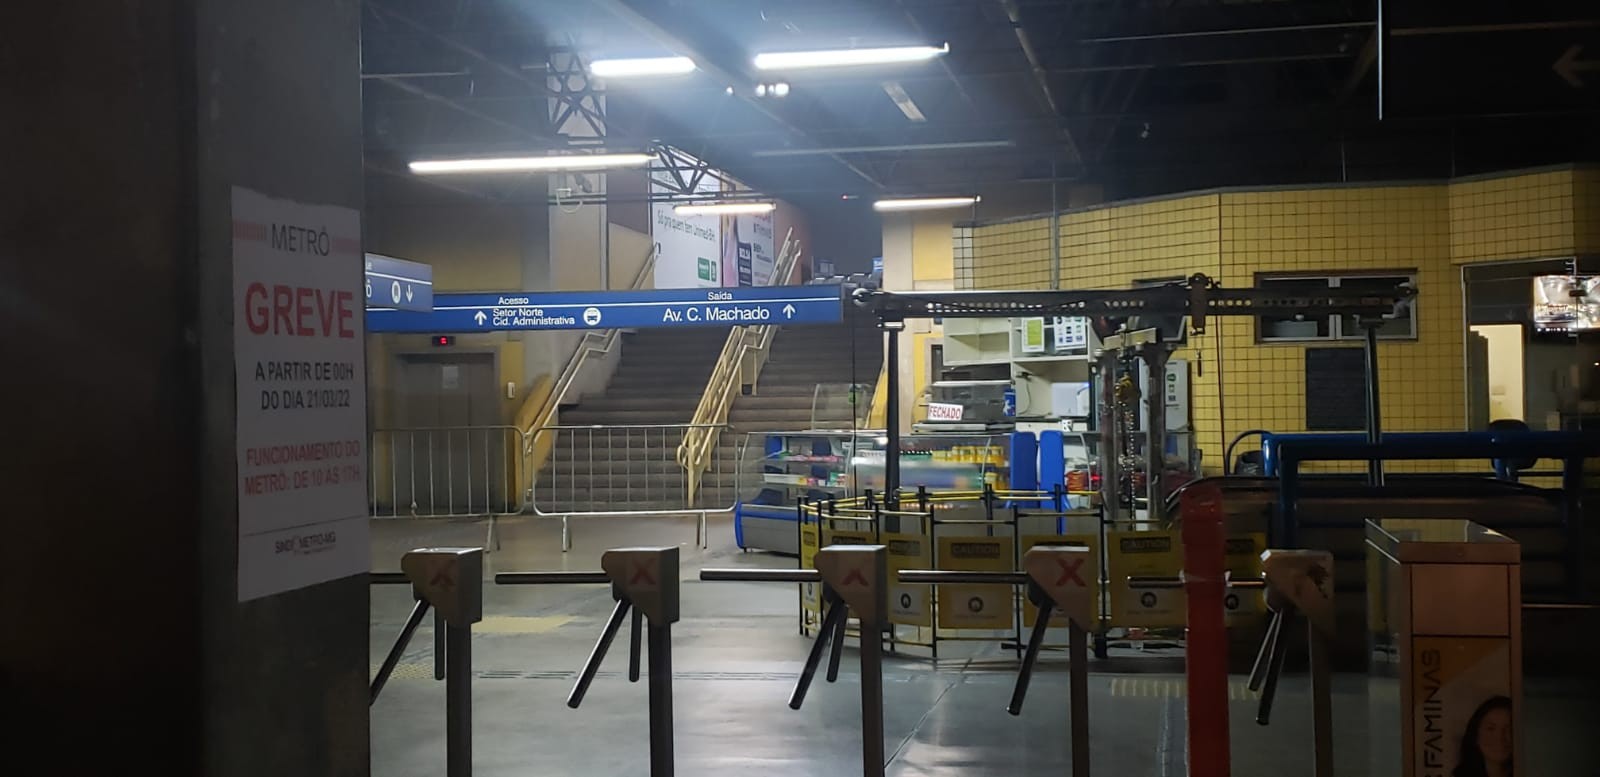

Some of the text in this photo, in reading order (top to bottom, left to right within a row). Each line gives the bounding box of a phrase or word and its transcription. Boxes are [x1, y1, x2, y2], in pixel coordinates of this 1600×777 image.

[271, 223, 329, 256] METRÔ
[498, 295, 529, 305] Acesso
[707, 290, 732, 301] Saída
[245, 282, 354, 338] GREVE
[492, 307, 543, 317] Setor Norte
[662, 304, 770, 322] Av. C. Machado
[492, 314, 576, 326] Cid. Administrativa
[255, 362, 354, 381] A PARTIR DE 00H
[261, 389, 350, 410] DO DIA 21/03/22
[929, 405, 961, 419] FECHADO
[247, 439, 360, 466] FUNCIONAMENTO DO
[293, 470, 310, 489] DE
[1421, 647, 1443, 769] FAMINAS
